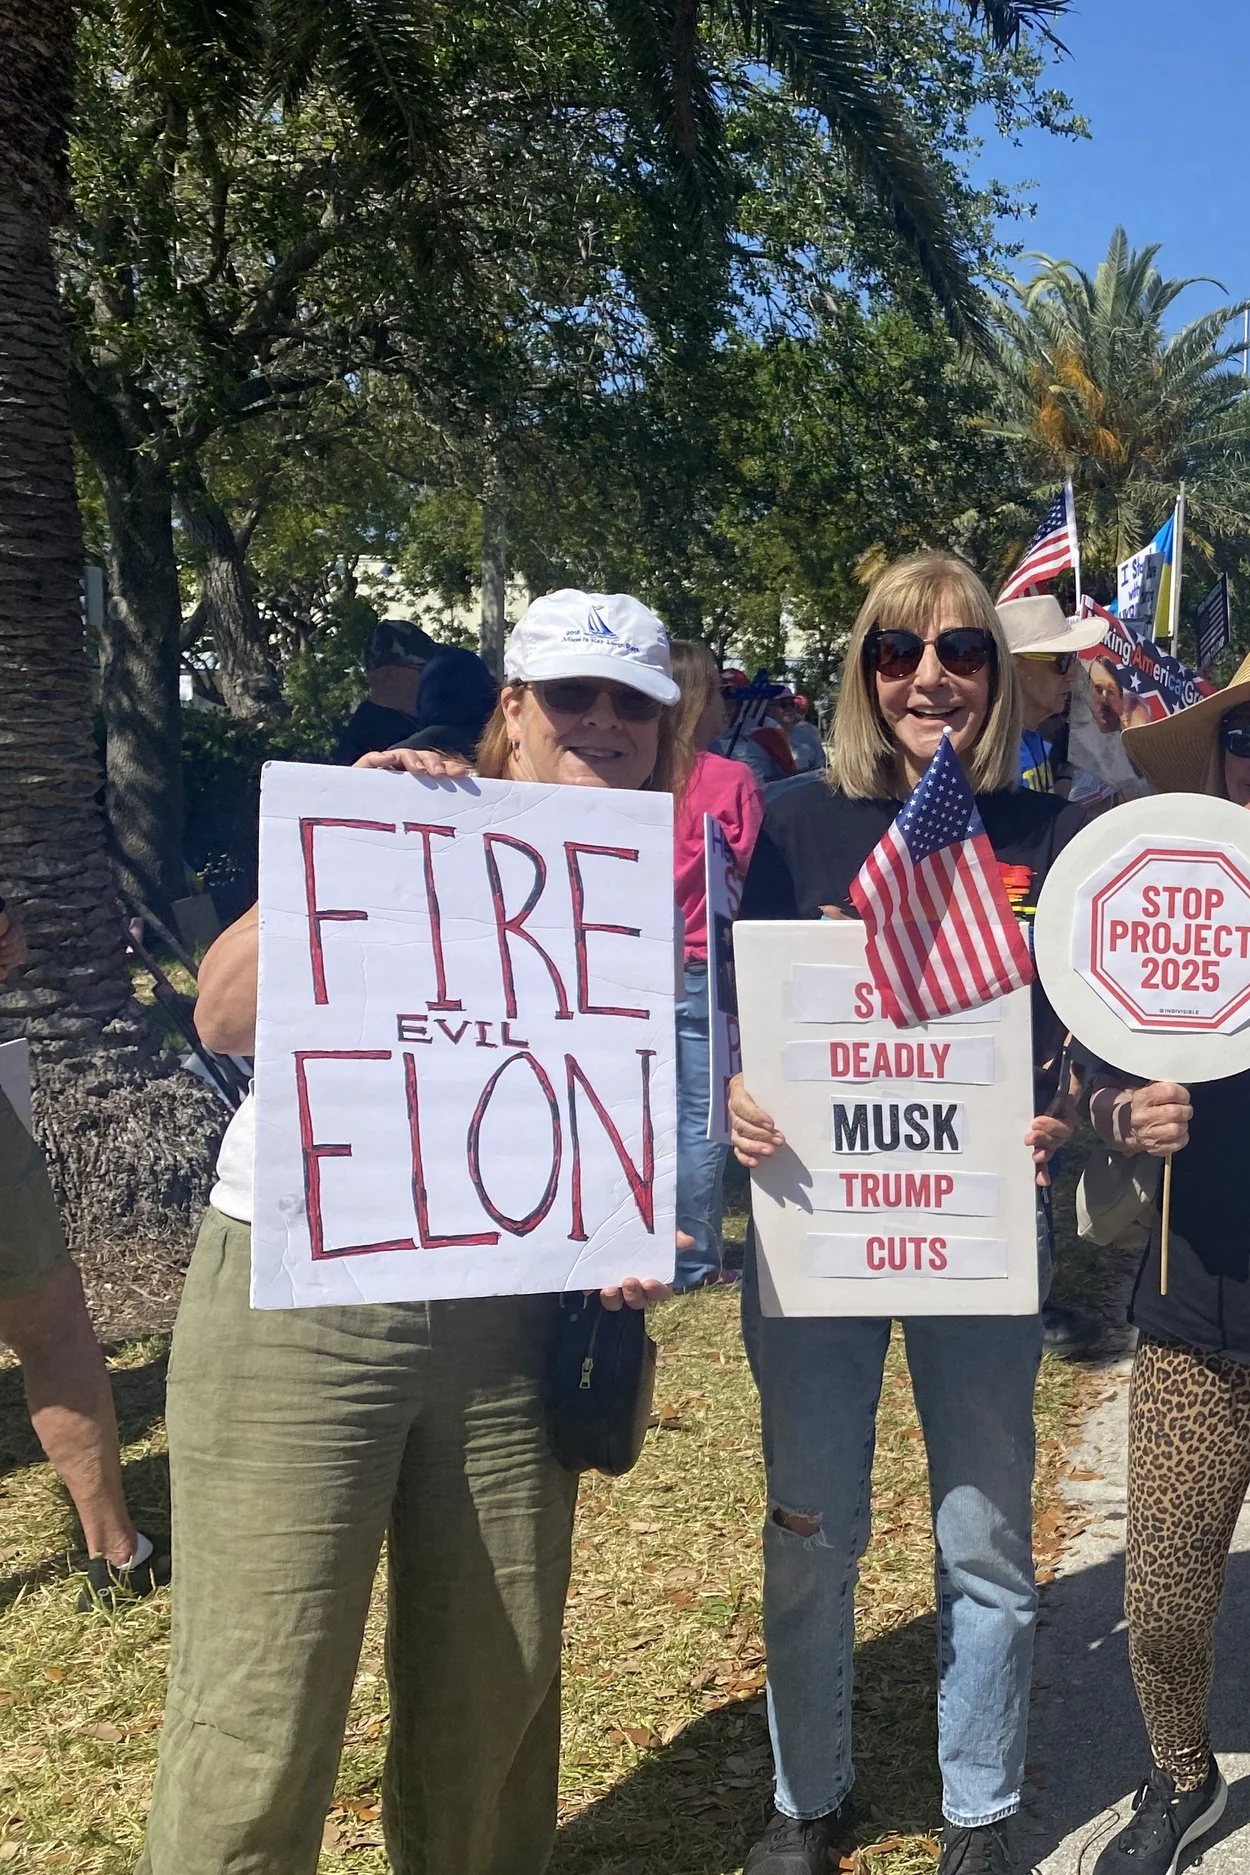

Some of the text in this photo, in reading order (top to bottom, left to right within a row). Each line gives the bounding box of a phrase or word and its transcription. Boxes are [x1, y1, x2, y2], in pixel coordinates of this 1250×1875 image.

[299, 816, 650, 1020] FIRE
[1141, 885, 1225, 920] STOP
[1141, 957, 1220, 992] 2025
[396, 1013, 529, 1049] EVIL
[828, 1041, 951, 1079] DEADLY
[832, 1103, 960, 1152] MUSK
[292, 1049, 657, 1260] ELON
[838, 1172, 955, 1208] TRUMP
[865, 1236, 948, 1271] CUTS
